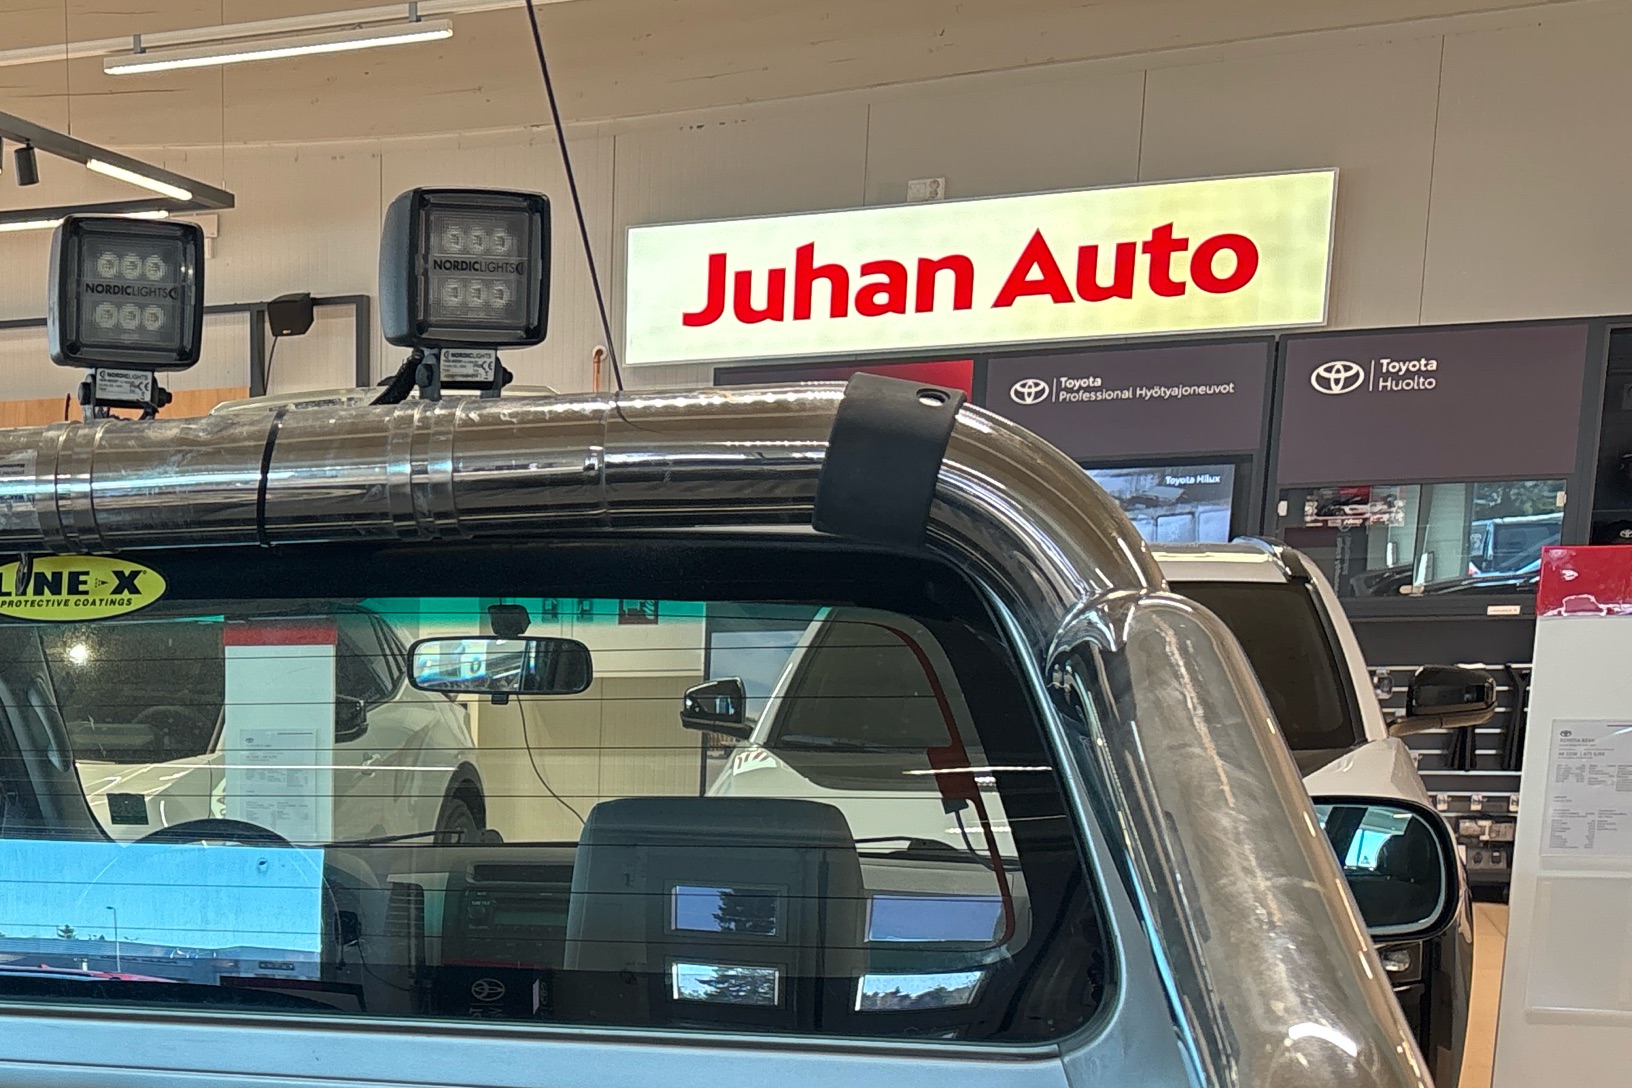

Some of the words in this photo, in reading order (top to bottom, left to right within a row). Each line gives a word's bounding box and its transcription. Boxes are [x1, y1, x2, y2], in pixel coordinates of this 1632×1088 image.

[433, 259, 516, 274] NORDICLIGHTS
[682, 241, 974, 327] Juhan
[991, 221, 1260, 309] Auto
[85, 283, 168, 298] NORDICLIGHTS
[1379, 357, 1438, 375] Toyota
[1059, 376, 1102, 390] Toyota
[1378, 375, 1436, 392] Huolto
[1059, 387, 1133, 402] Professional
[1136, 382, 1235, 400] Hyötyajoneuvot
[1165, 475, 1195, 486] Toyota
[1196, 474, 1221, 484] Hilux
[0, 598, 70, 609] PROTECTIVE
[73, 597, 133, 608] COATINGS
